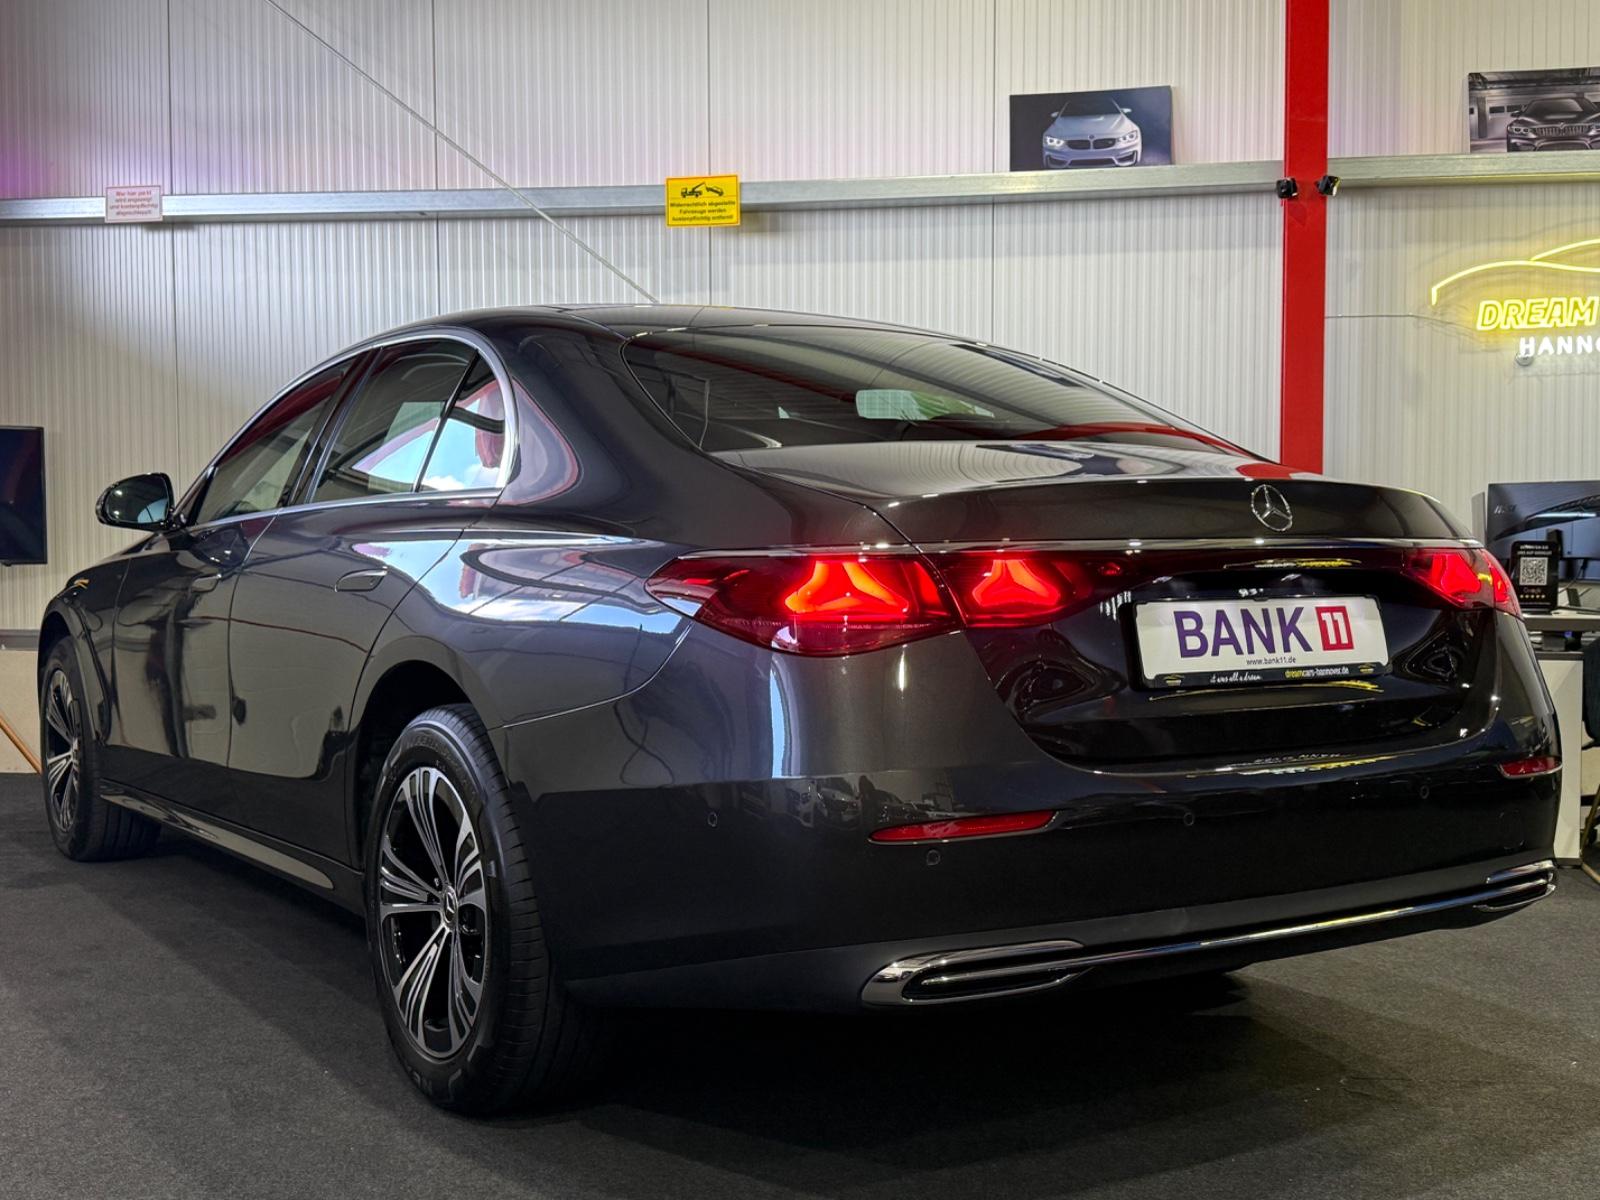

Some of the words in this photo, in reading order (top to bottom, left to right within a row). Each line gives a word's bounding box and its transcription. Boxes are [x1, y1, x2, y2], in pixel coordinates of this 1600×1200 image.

[1476, 296, 1600, 331] DREAM
[1173, 606, 1313, 658] BANK
[1320, 611, 1350, 647] 11
[1246, 656, 1296, 666] www.bank11.de
